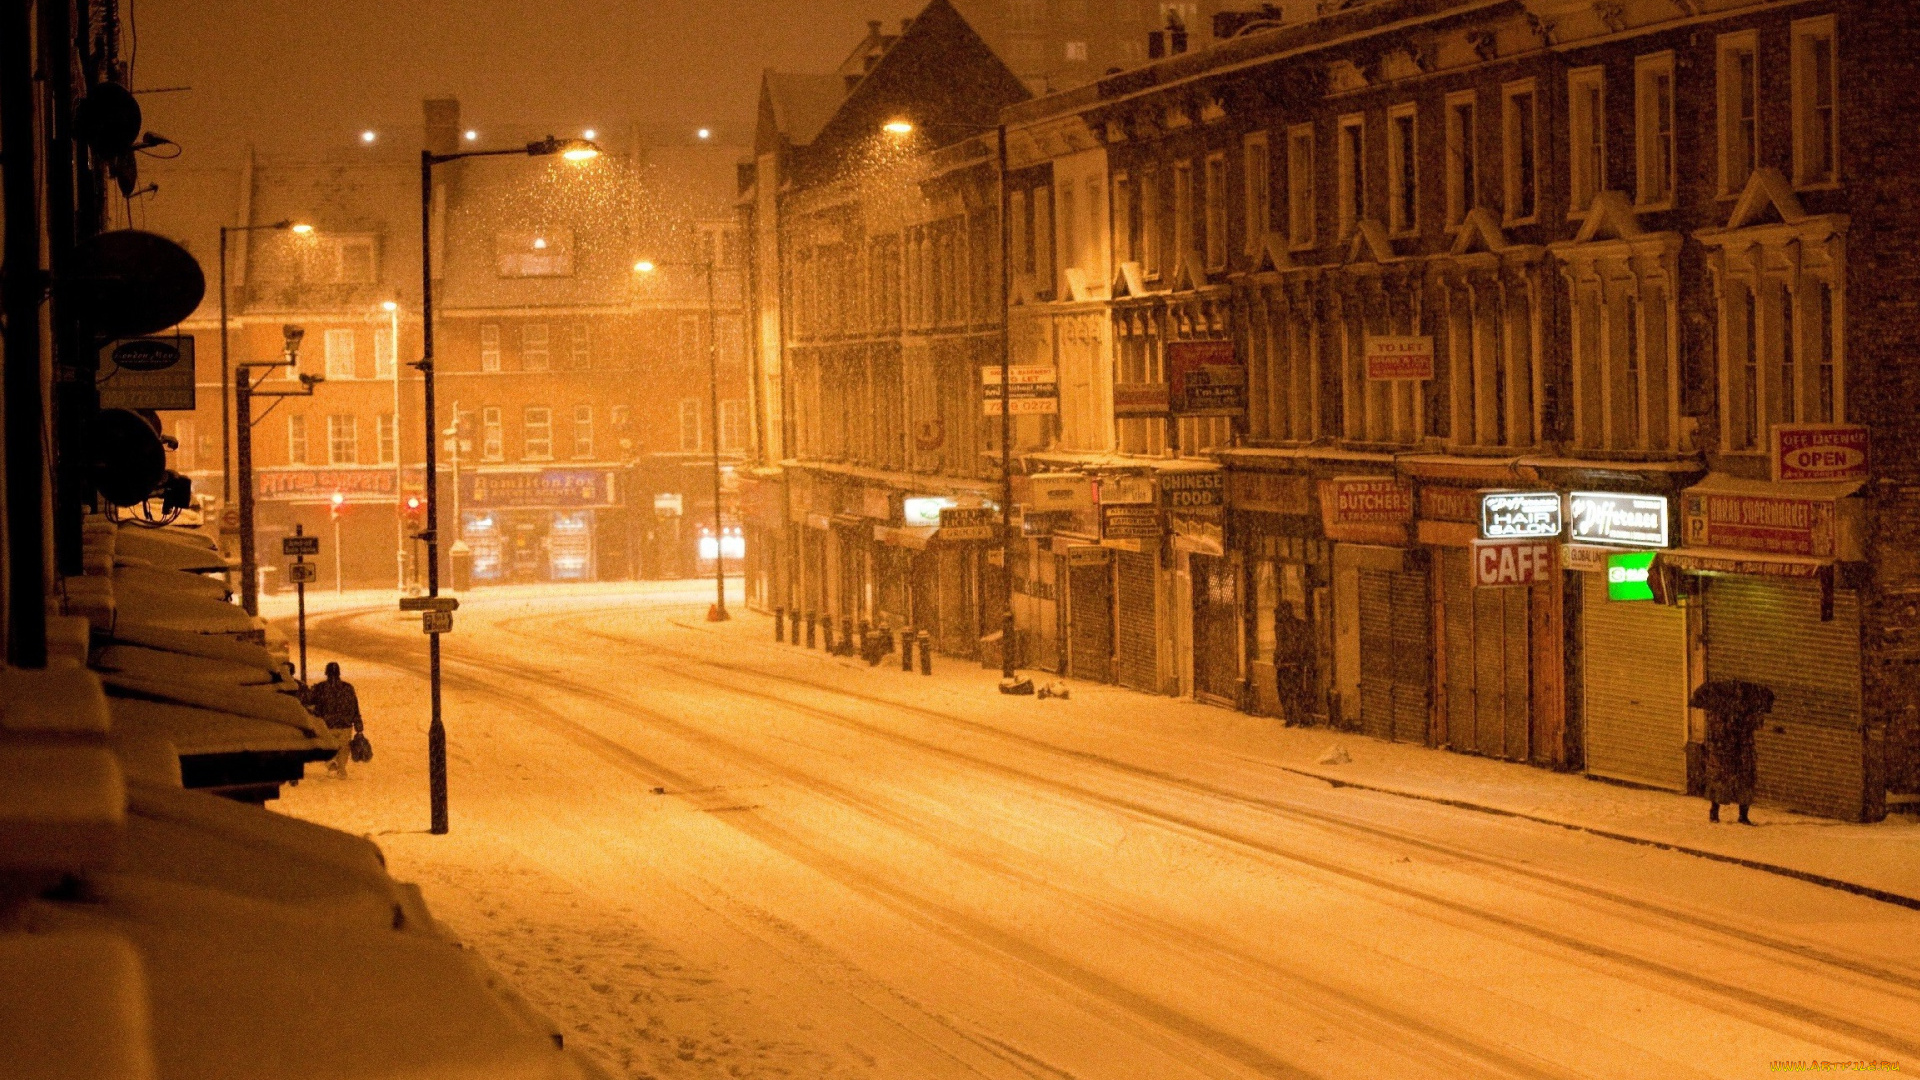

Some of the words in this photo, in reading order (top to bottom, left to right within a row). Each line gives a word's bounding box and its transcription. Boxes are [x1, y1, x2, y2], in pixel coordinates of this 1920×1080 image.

[1378, 343, 1395, 352] TO
[1400, 343, 1422, 352] LET
[1783, 435, 1807, 446] OFF
[1812, 433, 1866, 445] LICENCE
[1798, 452, 1846, 467] OPEN
[1162, 474, 1222, 490] CHINESE
[1172, 491, 1212, 506] FOOD
[1340, 494, 1409, 509] BUTCHERS
[1494, 512, 1550, 525] HAIR
[1742, 500, 1808, 527] SUPERMARKET
[1489, 523, 1556, 535] SALON
[1480, 546, 1550, 583] CAFE
